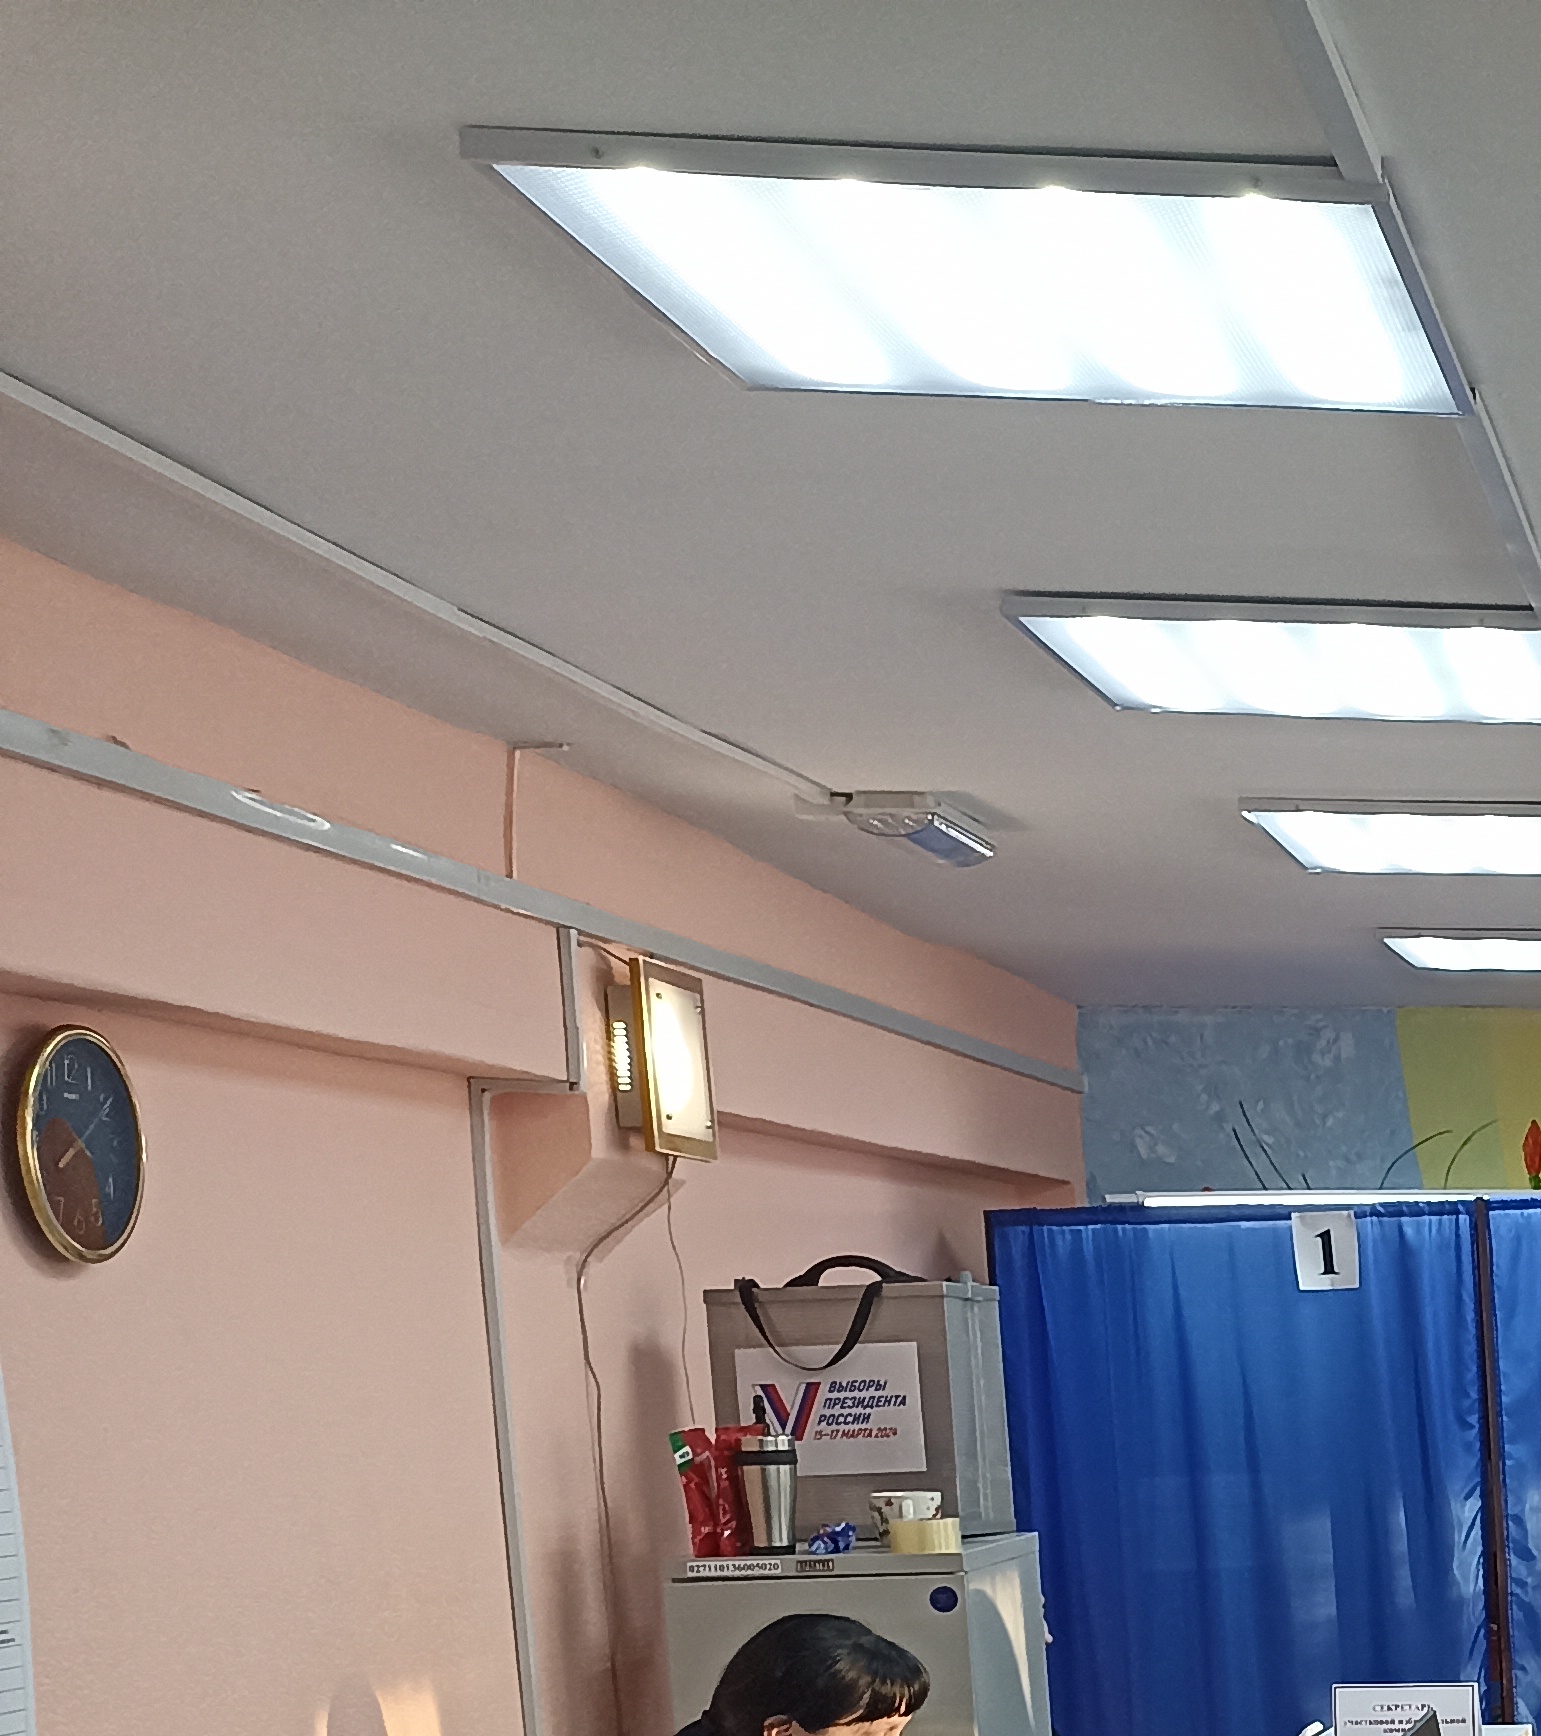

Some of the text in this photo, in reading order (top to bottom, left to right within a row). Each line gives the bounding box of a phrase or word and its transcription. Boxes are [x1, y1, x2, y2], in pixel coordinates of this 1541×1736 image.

[1314, 1228, 1340, 1276] 1
[828, 1379, 887, 1393] ВЫБОРЫ
[823, 1395, 907, 1410] ПРЕЗИДЕНТА
[817, 1412, 872, 1426] РОССИИ
[840, 1428, 873, 1440] МАРТА
[874, 1427, 898, 1439] 2024
